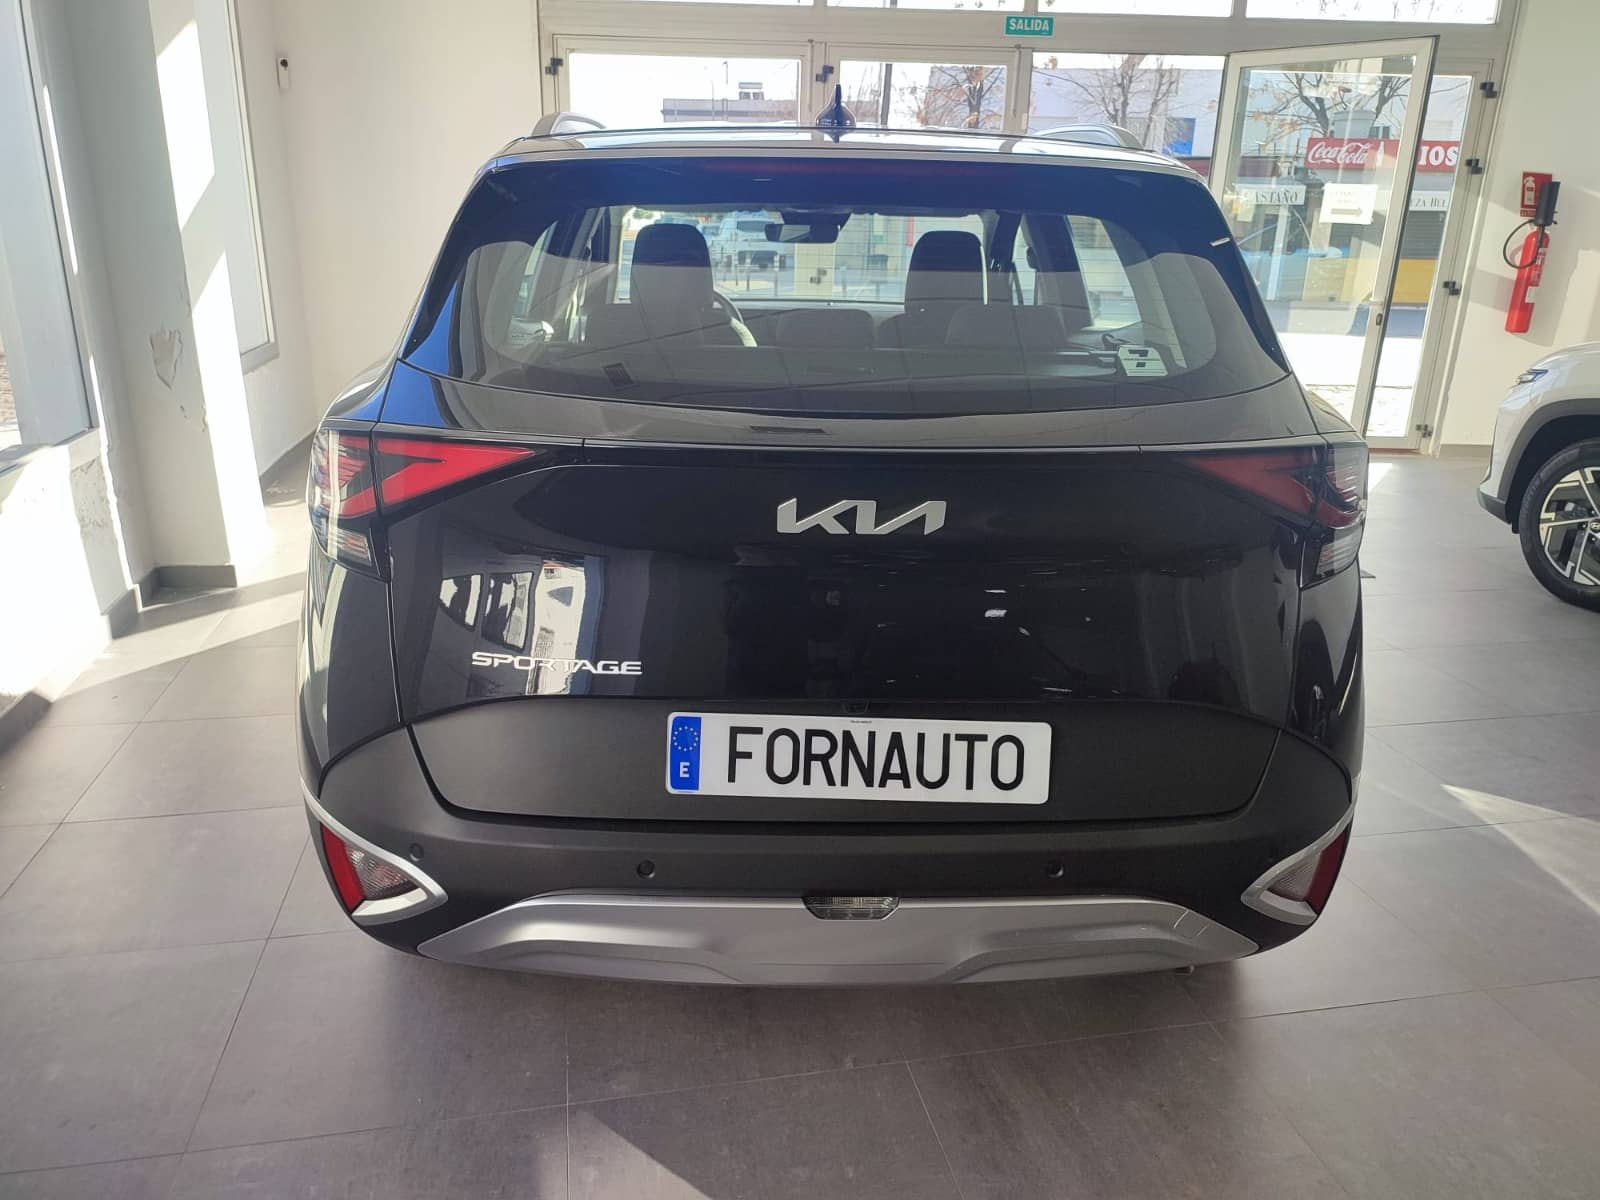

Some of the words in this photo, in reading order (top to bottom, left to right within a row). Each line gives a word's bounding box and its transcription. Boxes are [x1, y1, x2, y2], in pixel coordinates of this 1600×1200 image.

[1009, 18, 1049, 32] SALIDA
[777, 498, 947, 535] KIA
[472, 651, 643, 675] SPORTAGE
[679, 762, 690, 778] E
[727, 726, 1025, 791] FORNAUTO
